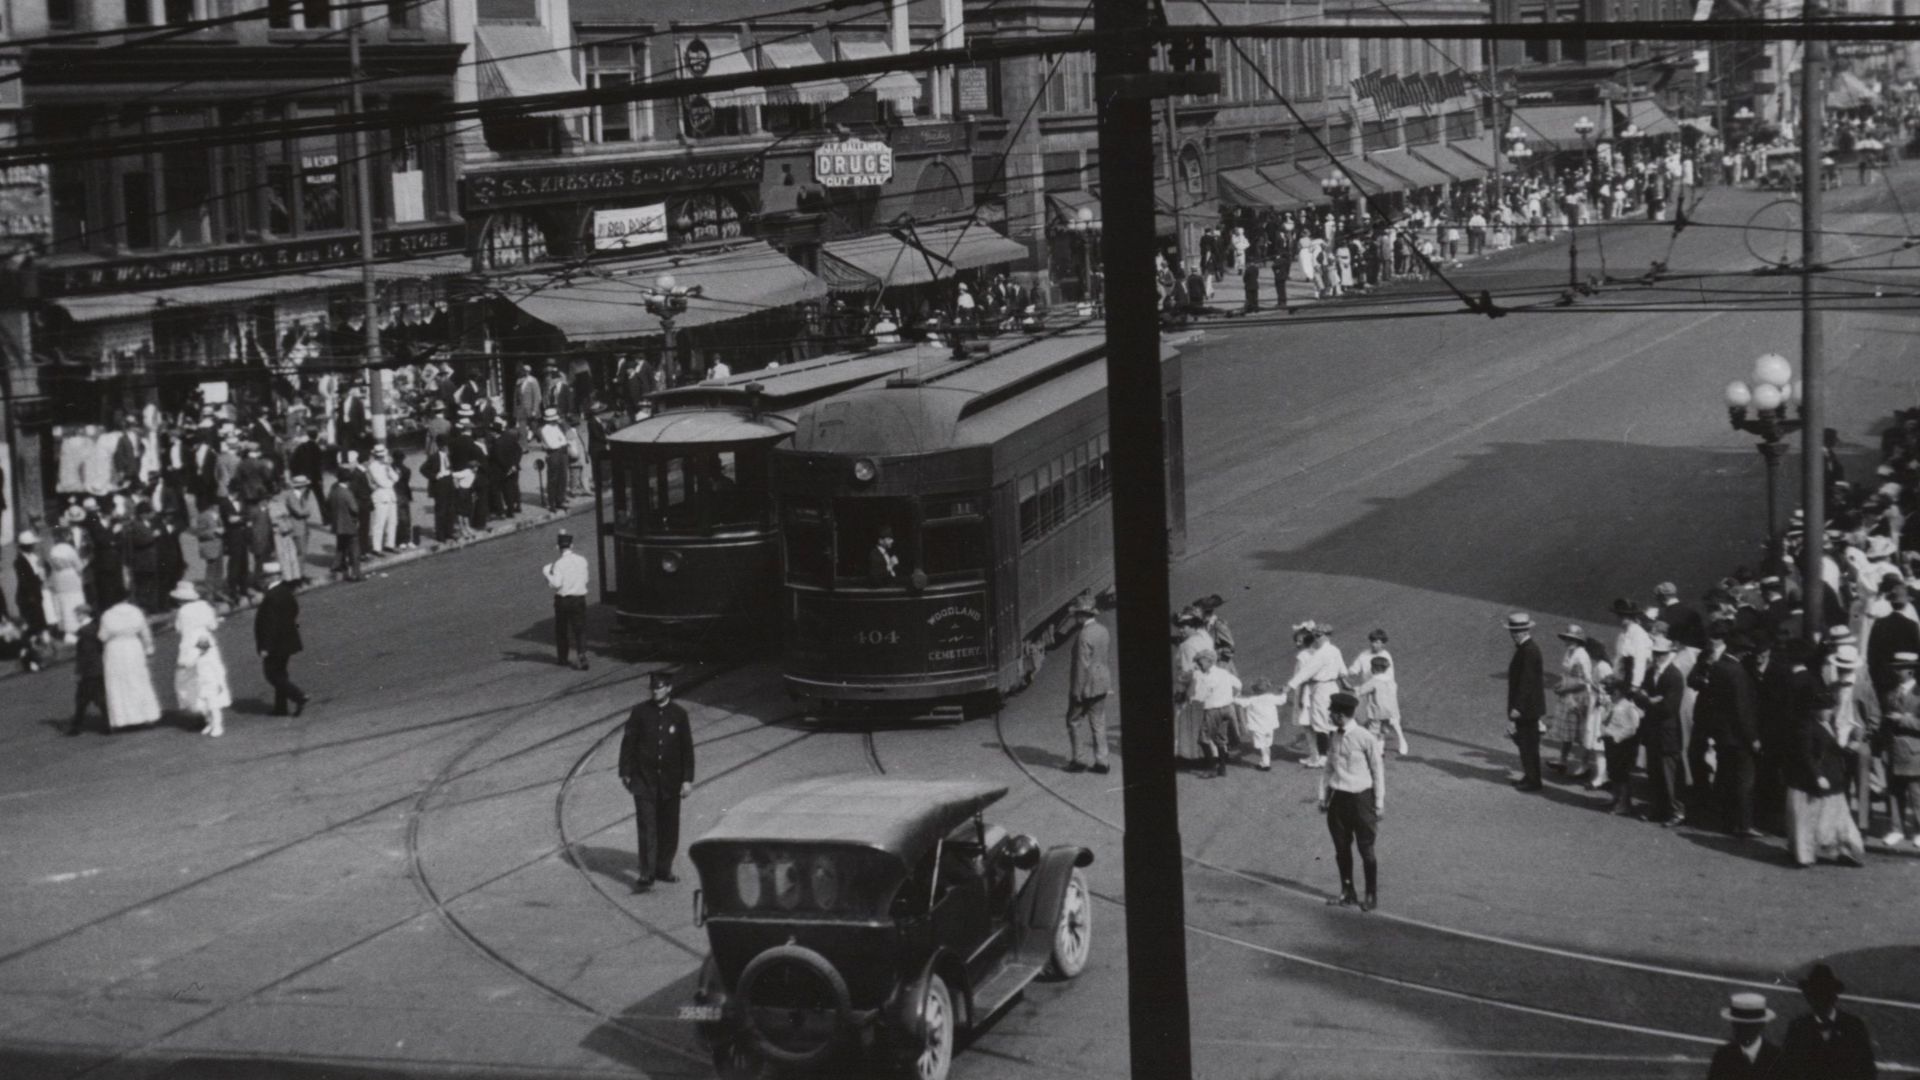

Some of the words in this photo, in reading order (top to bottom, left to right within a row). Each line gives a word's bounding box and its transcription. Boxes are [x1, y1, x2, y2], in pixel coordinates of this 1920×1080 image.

[818, 153, 890, 175] DRUGS
[540, 168, 625, 193] KRESGE'S
[686, 161, 739, 179] STORE
[826, 176, 850, 187] CUT
[854, 175, 883, 186] RATE
[116, 256, 230, 281] WOOLWORTH
[352, 238, 392, 257] CNT
[400, 231, 449, 251] STORE
[926, 606, 981, 625] WOODLAND
[852, 630, 900, 645] 404
